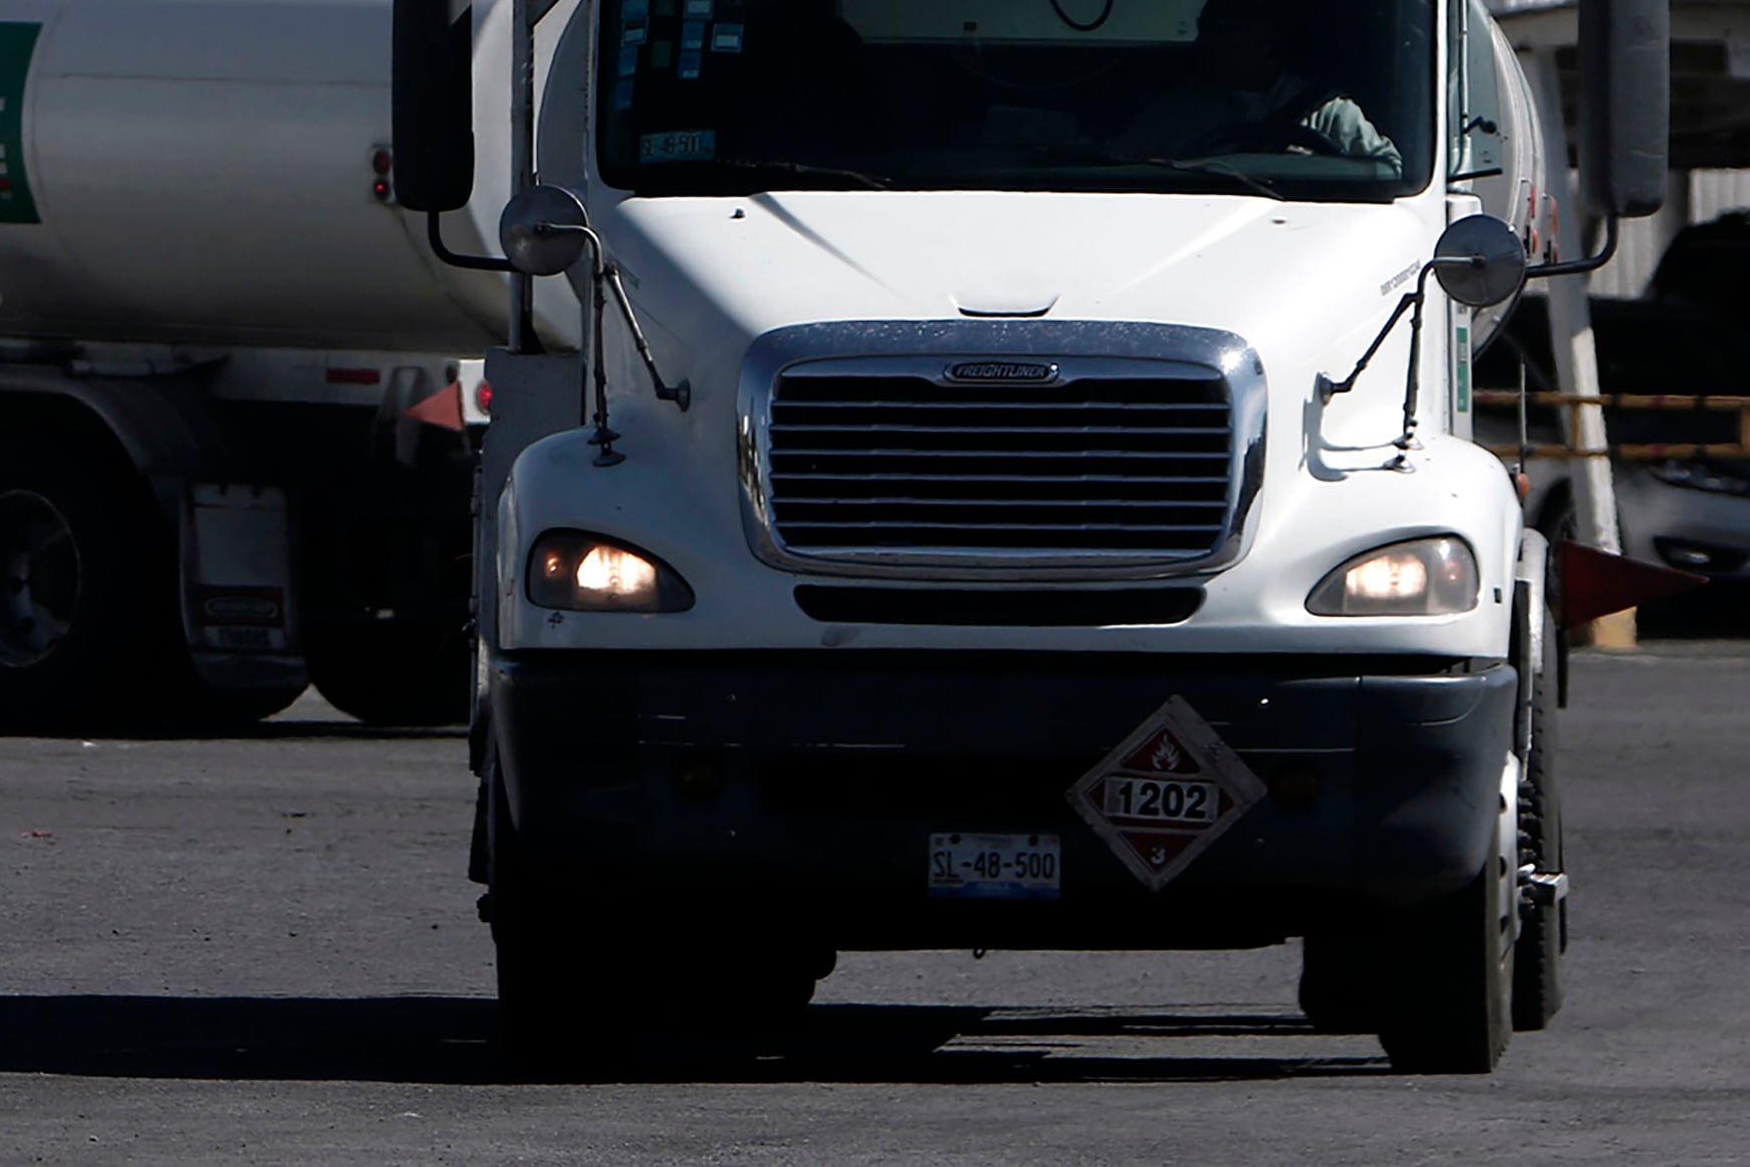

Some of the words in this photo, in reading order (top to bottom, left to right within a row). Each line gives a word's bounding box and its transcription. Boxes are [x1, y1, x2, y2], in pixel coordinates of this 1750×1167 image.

[956, 363, 1046, 378] FREIGHTLINER
[1118, 781, 1208, 819] 1202
[933, 850, 1055, 879] SL-48-500
[1150, 845, 1167, 865] 3
